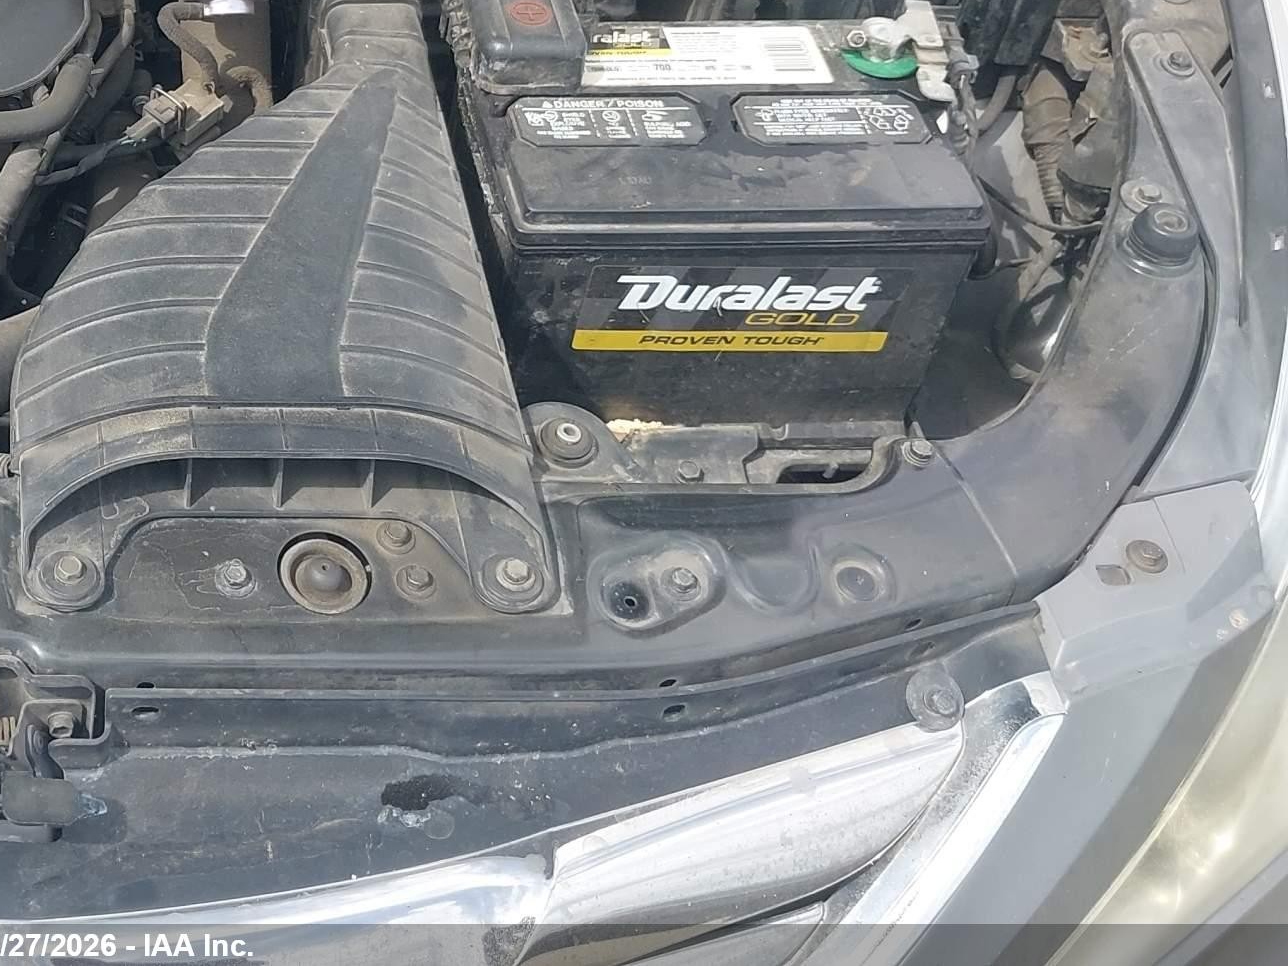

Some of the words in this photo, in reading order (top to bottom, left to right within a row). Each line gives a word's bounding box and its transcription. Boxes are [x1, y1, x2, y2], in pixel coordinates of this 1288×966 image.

[592, 30, 652, 43] ralast
[553, 100, 607, 108] DANGER
[616, 100, 665, 108] POISON
[616, 275, 880, 311] Duralast
[744, 312, 861, 326] GOLD
[638, 335, 737, 345] PROVEN
[742, 336, 823, 345] TOUGH
